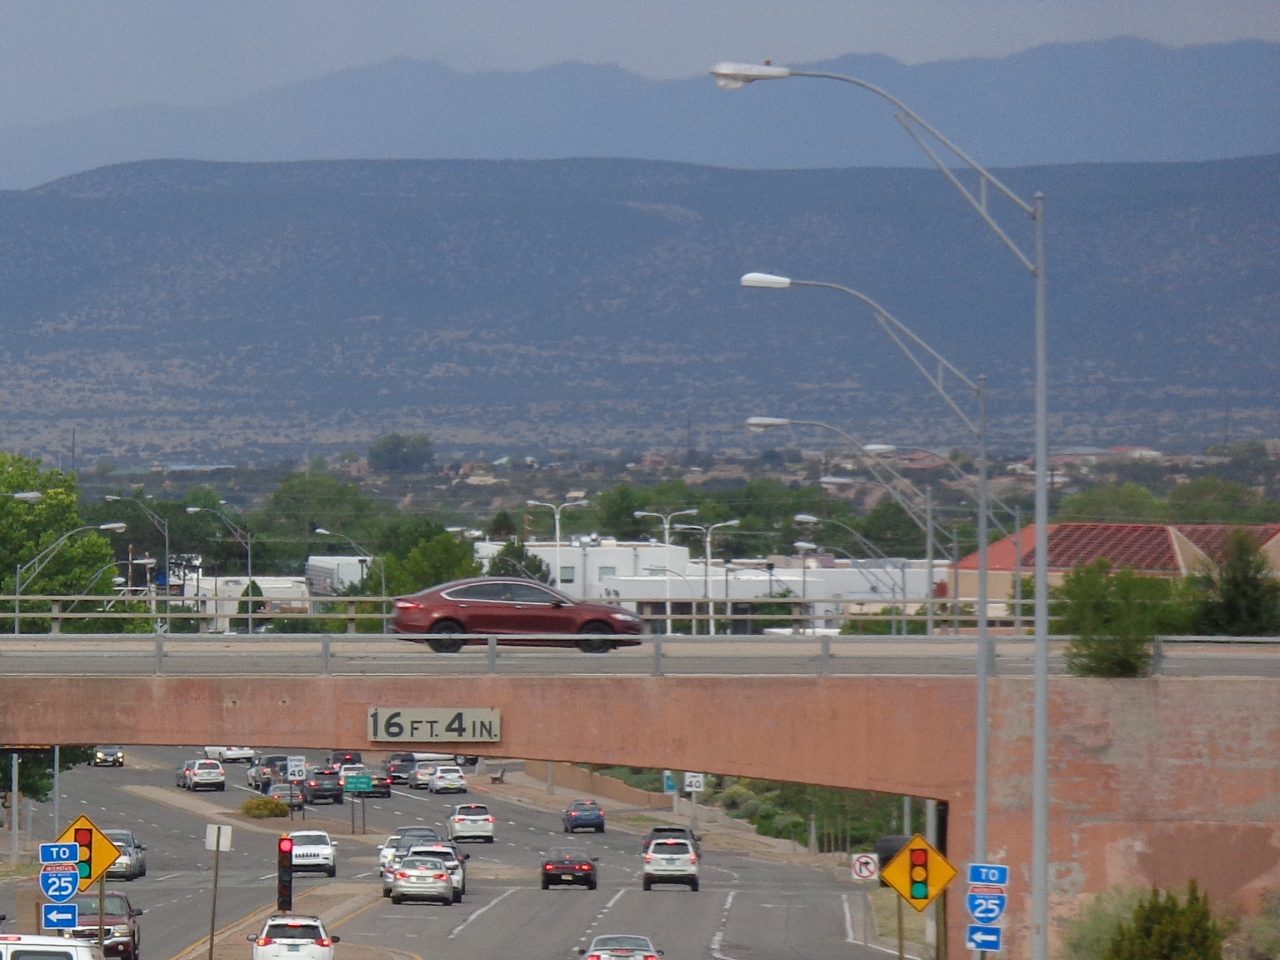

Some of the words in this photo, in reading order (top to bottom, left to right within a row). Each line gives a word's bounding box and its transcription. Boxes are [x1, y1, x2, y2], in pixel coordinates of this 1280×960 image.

[370, 711, 404, 738] 16
[410, 720, 438, 738] FT.
[445, 711, 466, 737] 4
[472, 720, 497, 739] IN.
[289, 769, 304, 778] 40
[685, 780, 701, 789] 40
[49, 847, 70, 859] TO
[979, 868, 1000, 881] TO
[47, 877, 73, 896] 25
[974, 898, 1001, 918] 25
